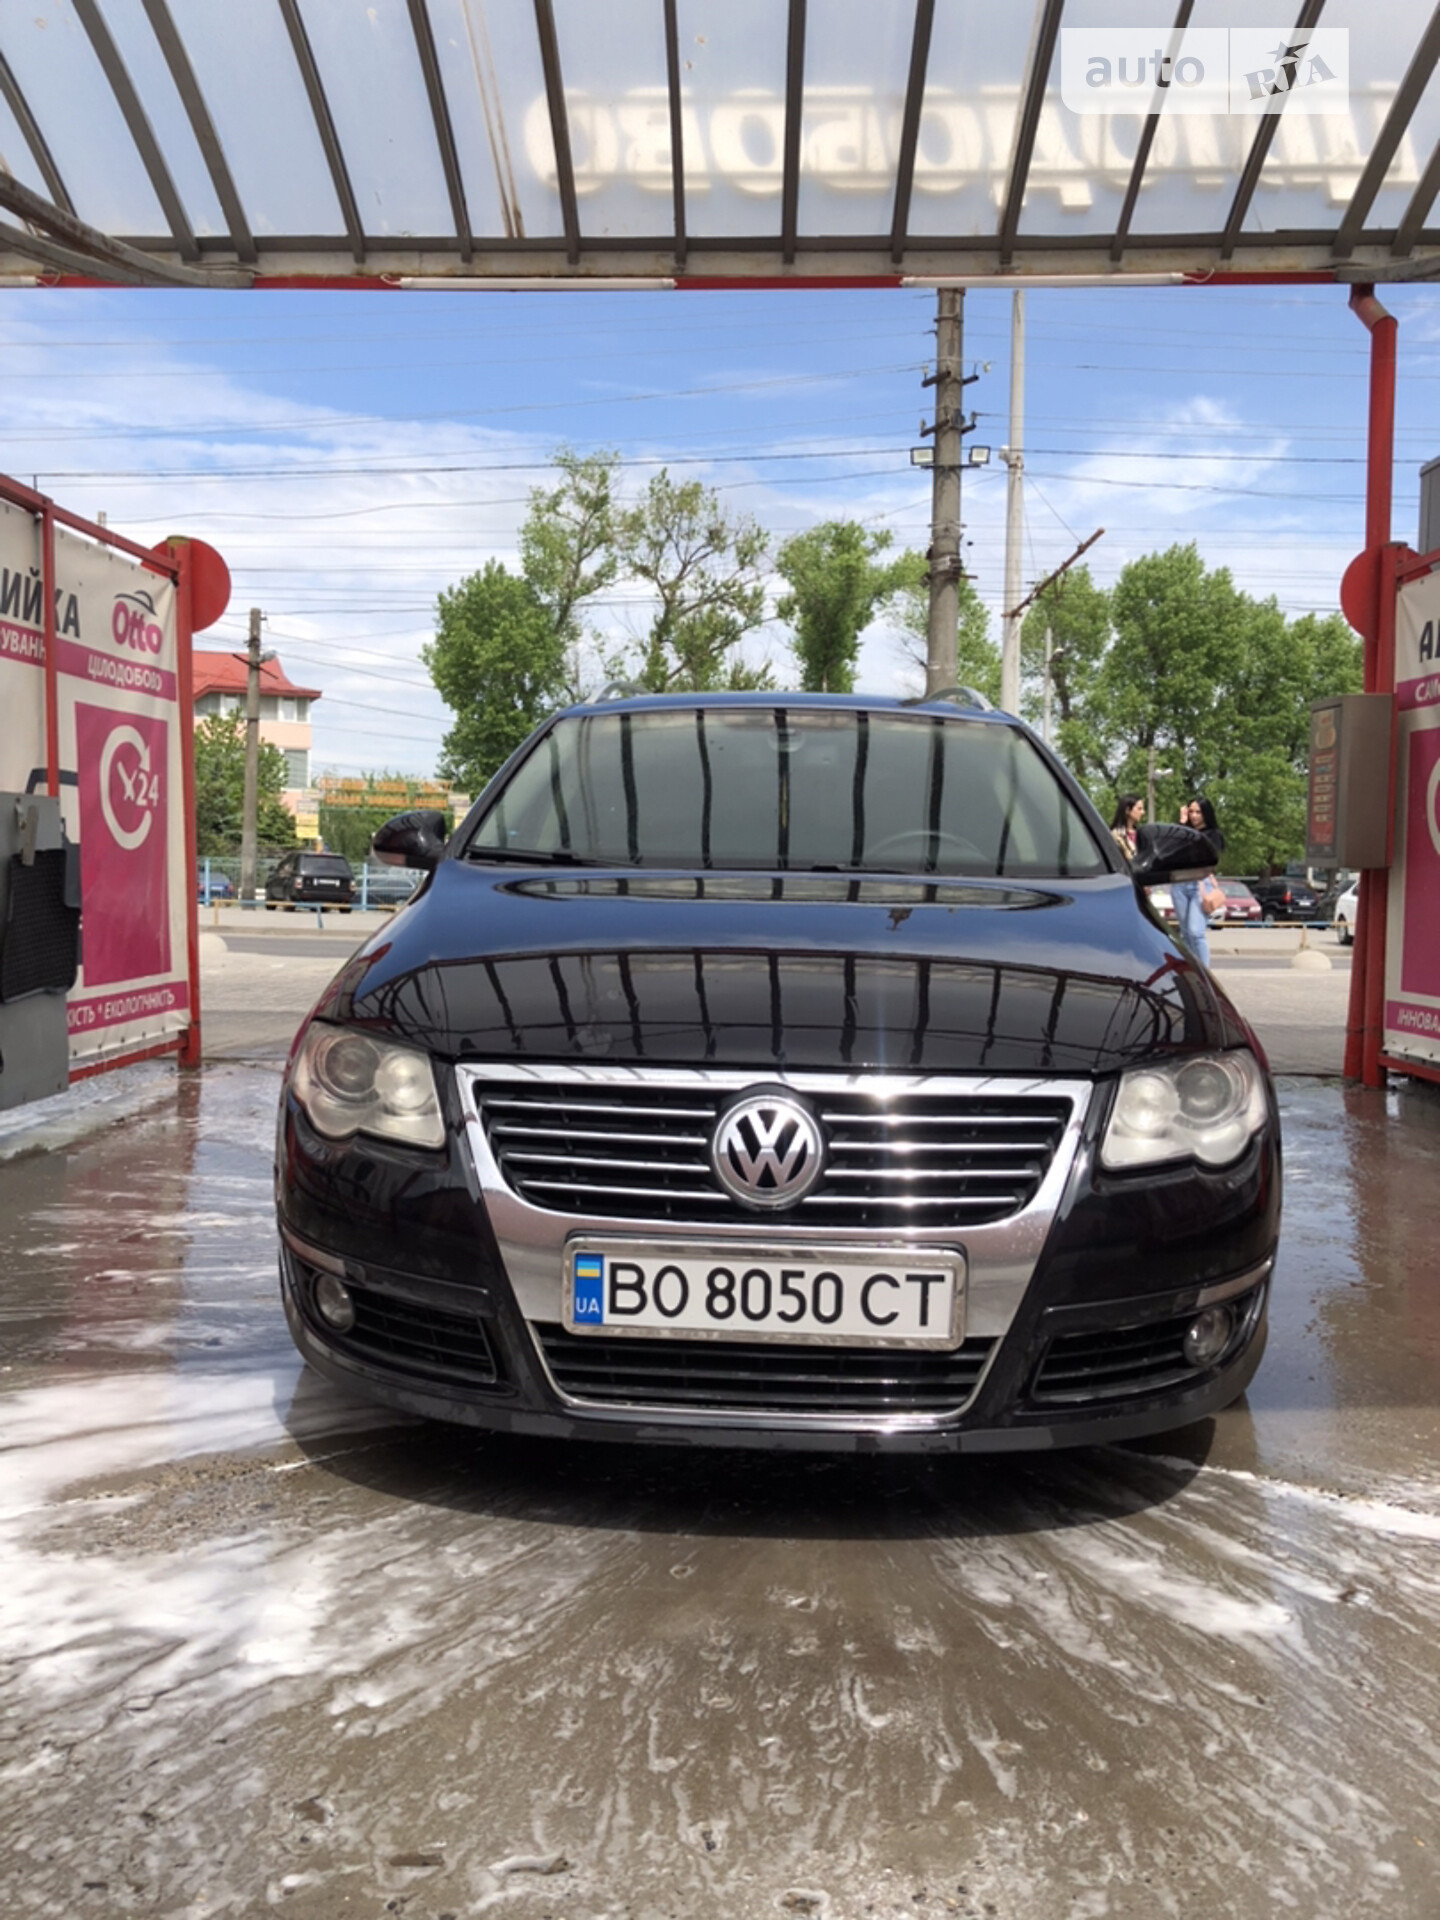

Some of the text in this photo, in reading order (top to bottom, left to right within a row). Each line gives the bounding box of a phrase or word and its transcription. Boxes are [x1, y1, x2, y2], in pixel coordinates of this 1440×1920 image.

[112, 599, 164, 655] Otto
[575, 1296, 600, 1315] UA
[608, 1261, 946, 1327] BO 8050 CT
